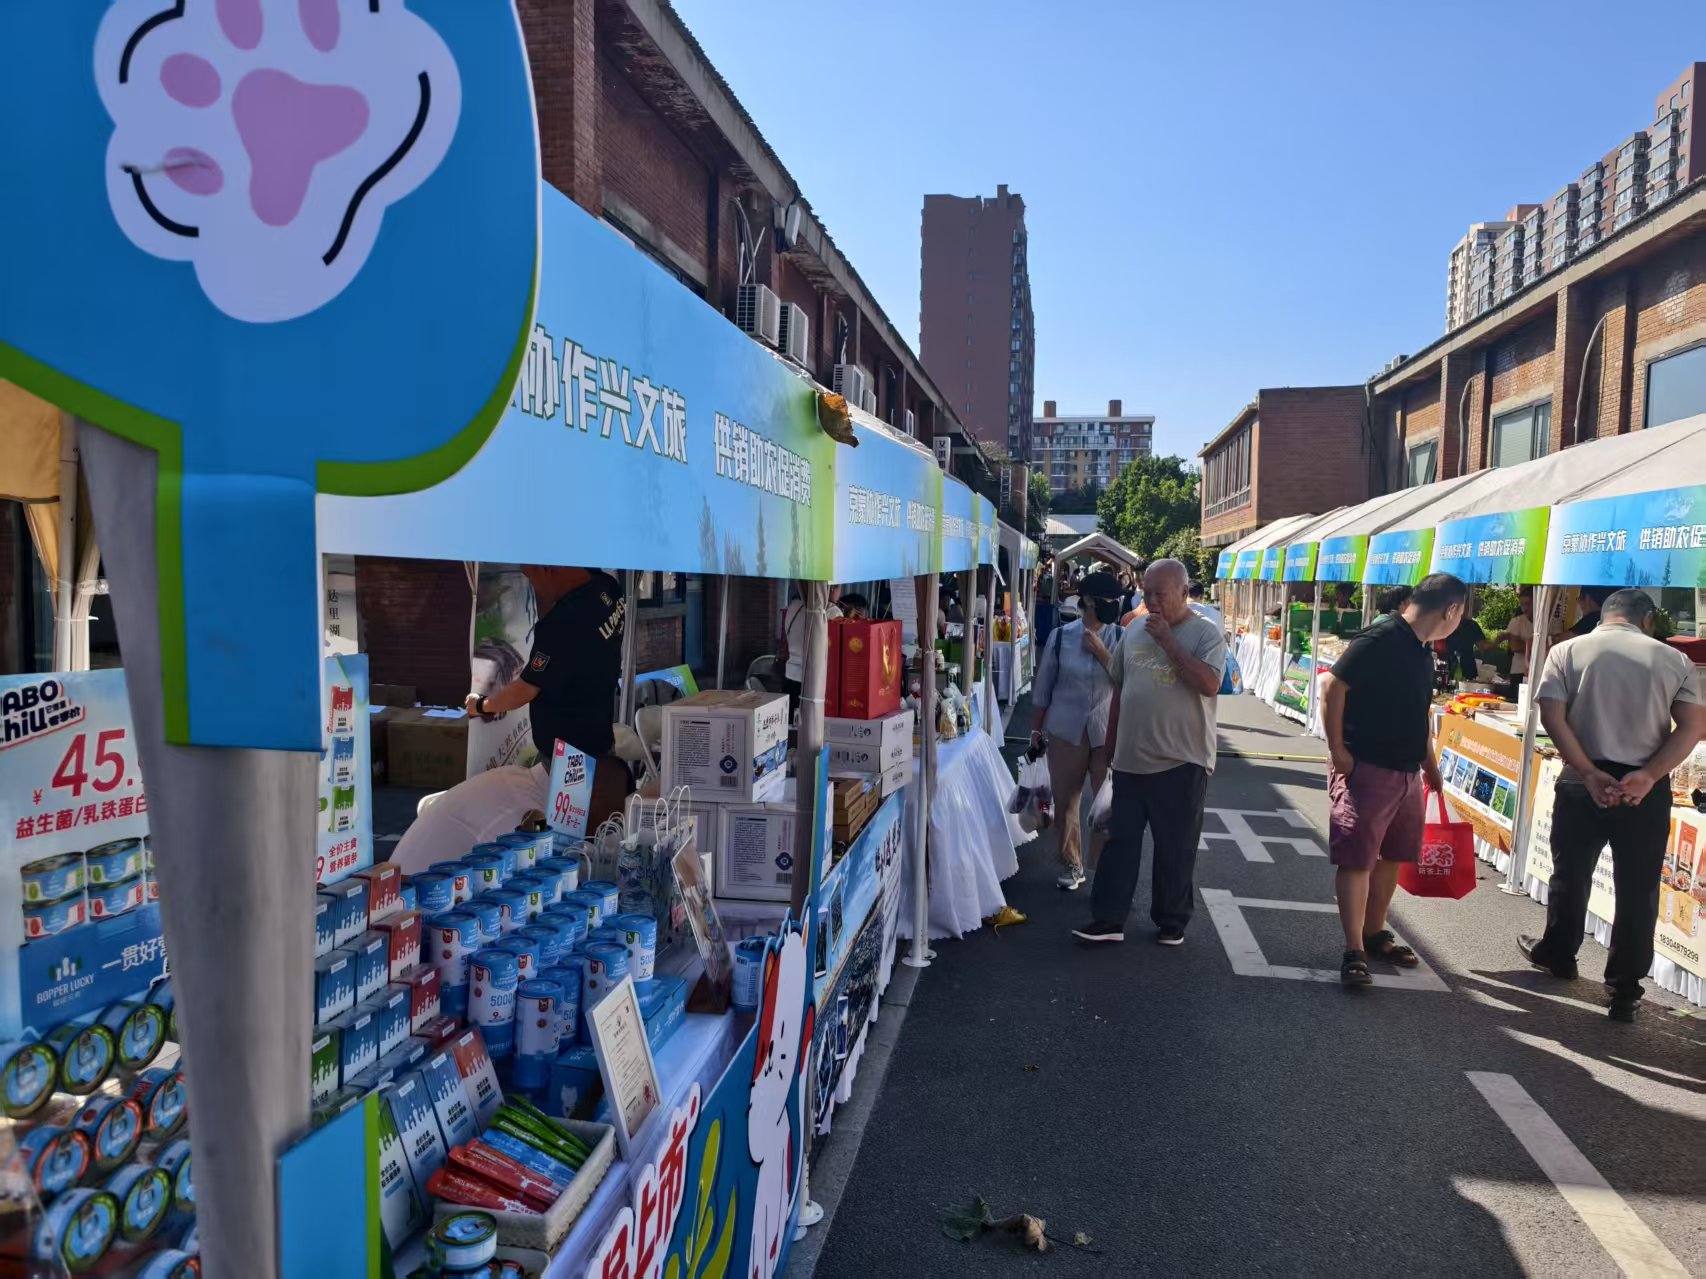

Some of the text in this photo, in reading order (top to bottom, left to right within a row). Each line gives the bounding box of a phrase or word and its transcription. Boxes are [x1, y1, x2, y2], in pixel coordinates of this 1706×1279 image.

[714, 410, 813, 508] 供销助农促消费
[0, 680, 59, 718] ABO
